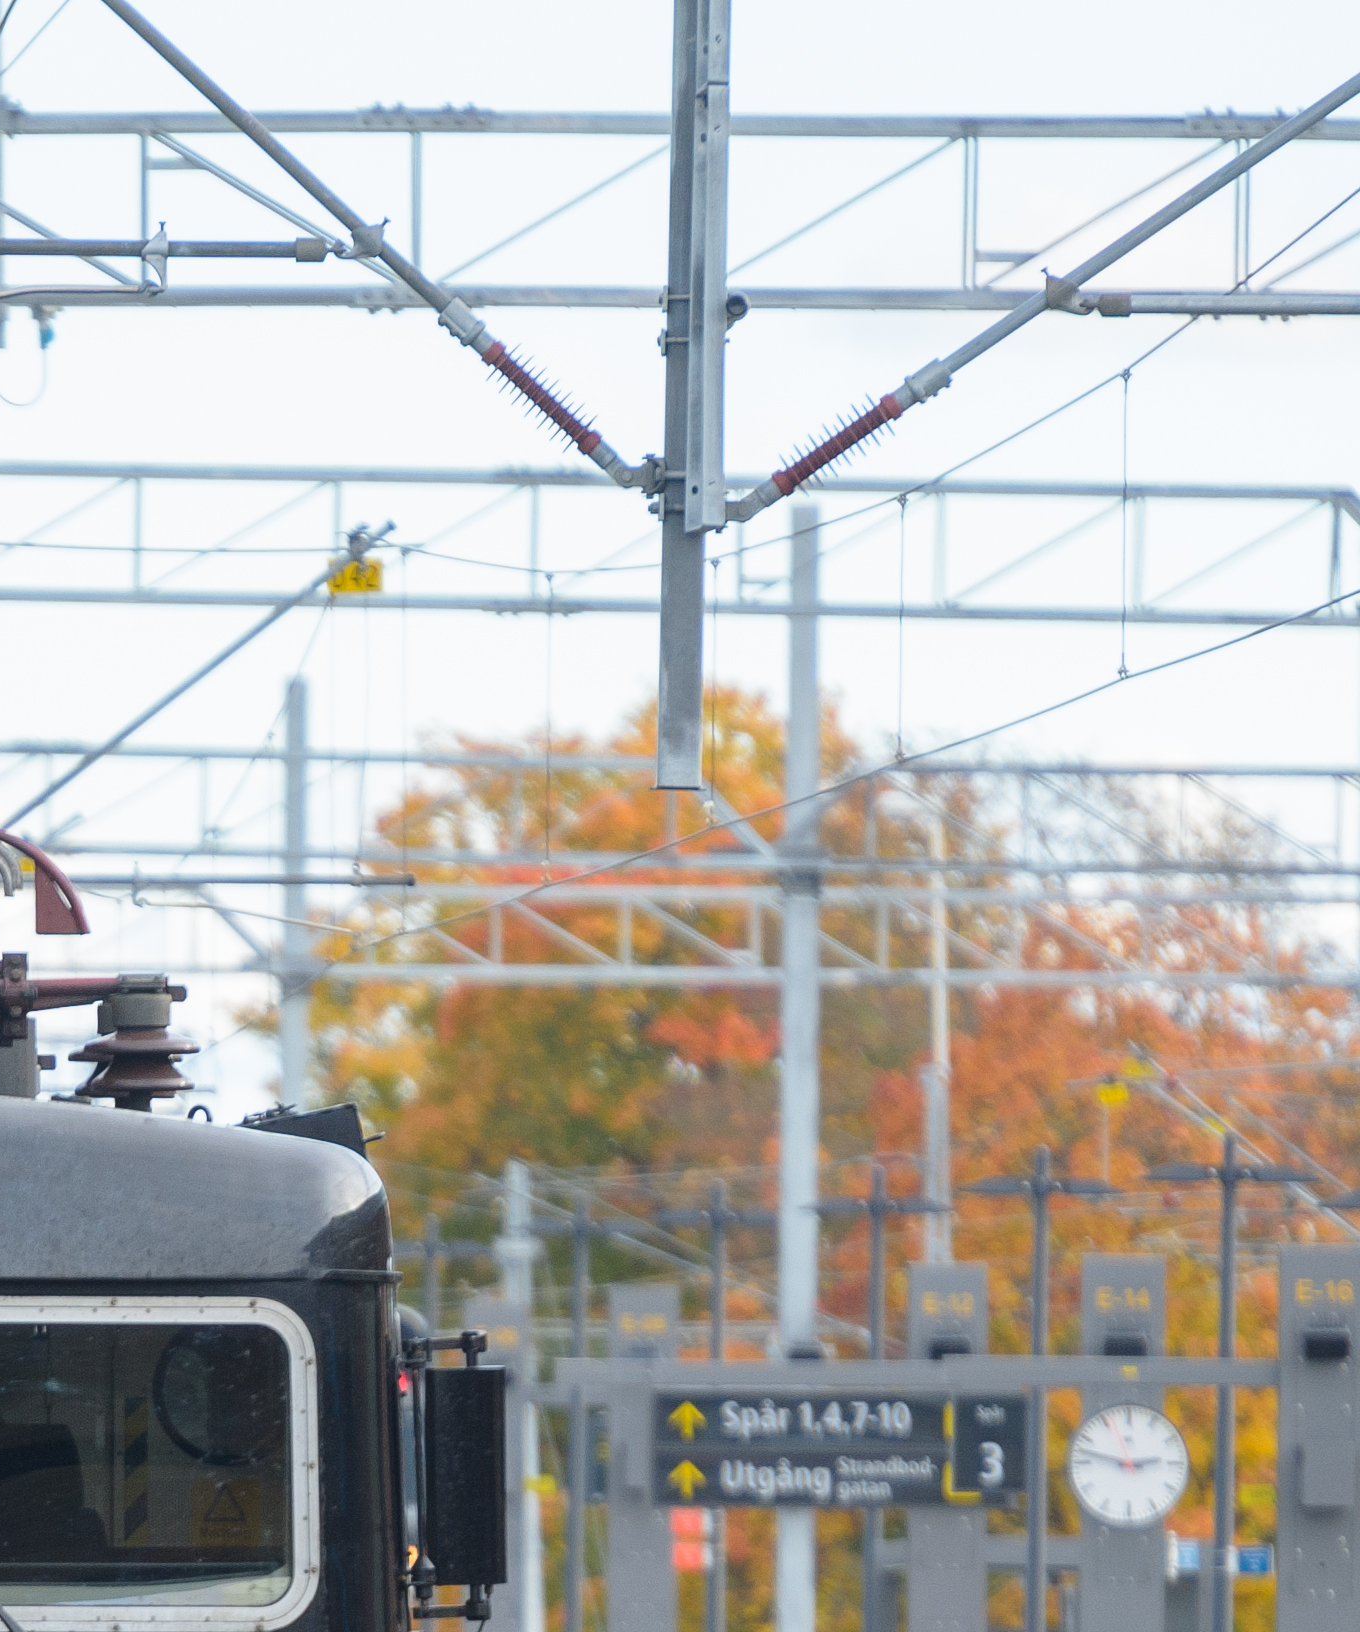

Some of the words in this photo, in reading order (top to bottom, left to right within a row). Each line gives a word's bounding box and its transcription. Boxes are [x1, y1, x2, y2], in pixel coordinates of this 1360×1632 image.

[1295, 1278, 1355, 1304] E-16
[720, 1399, 789, 1439] Spår
[797, 1400, 912, 1437] 1,4,7-10
[720, 1457, 831, 1499] Utgång
[980, 1441, 1005, 1484] 3
[837, 1479, 893, 1500] gatan
